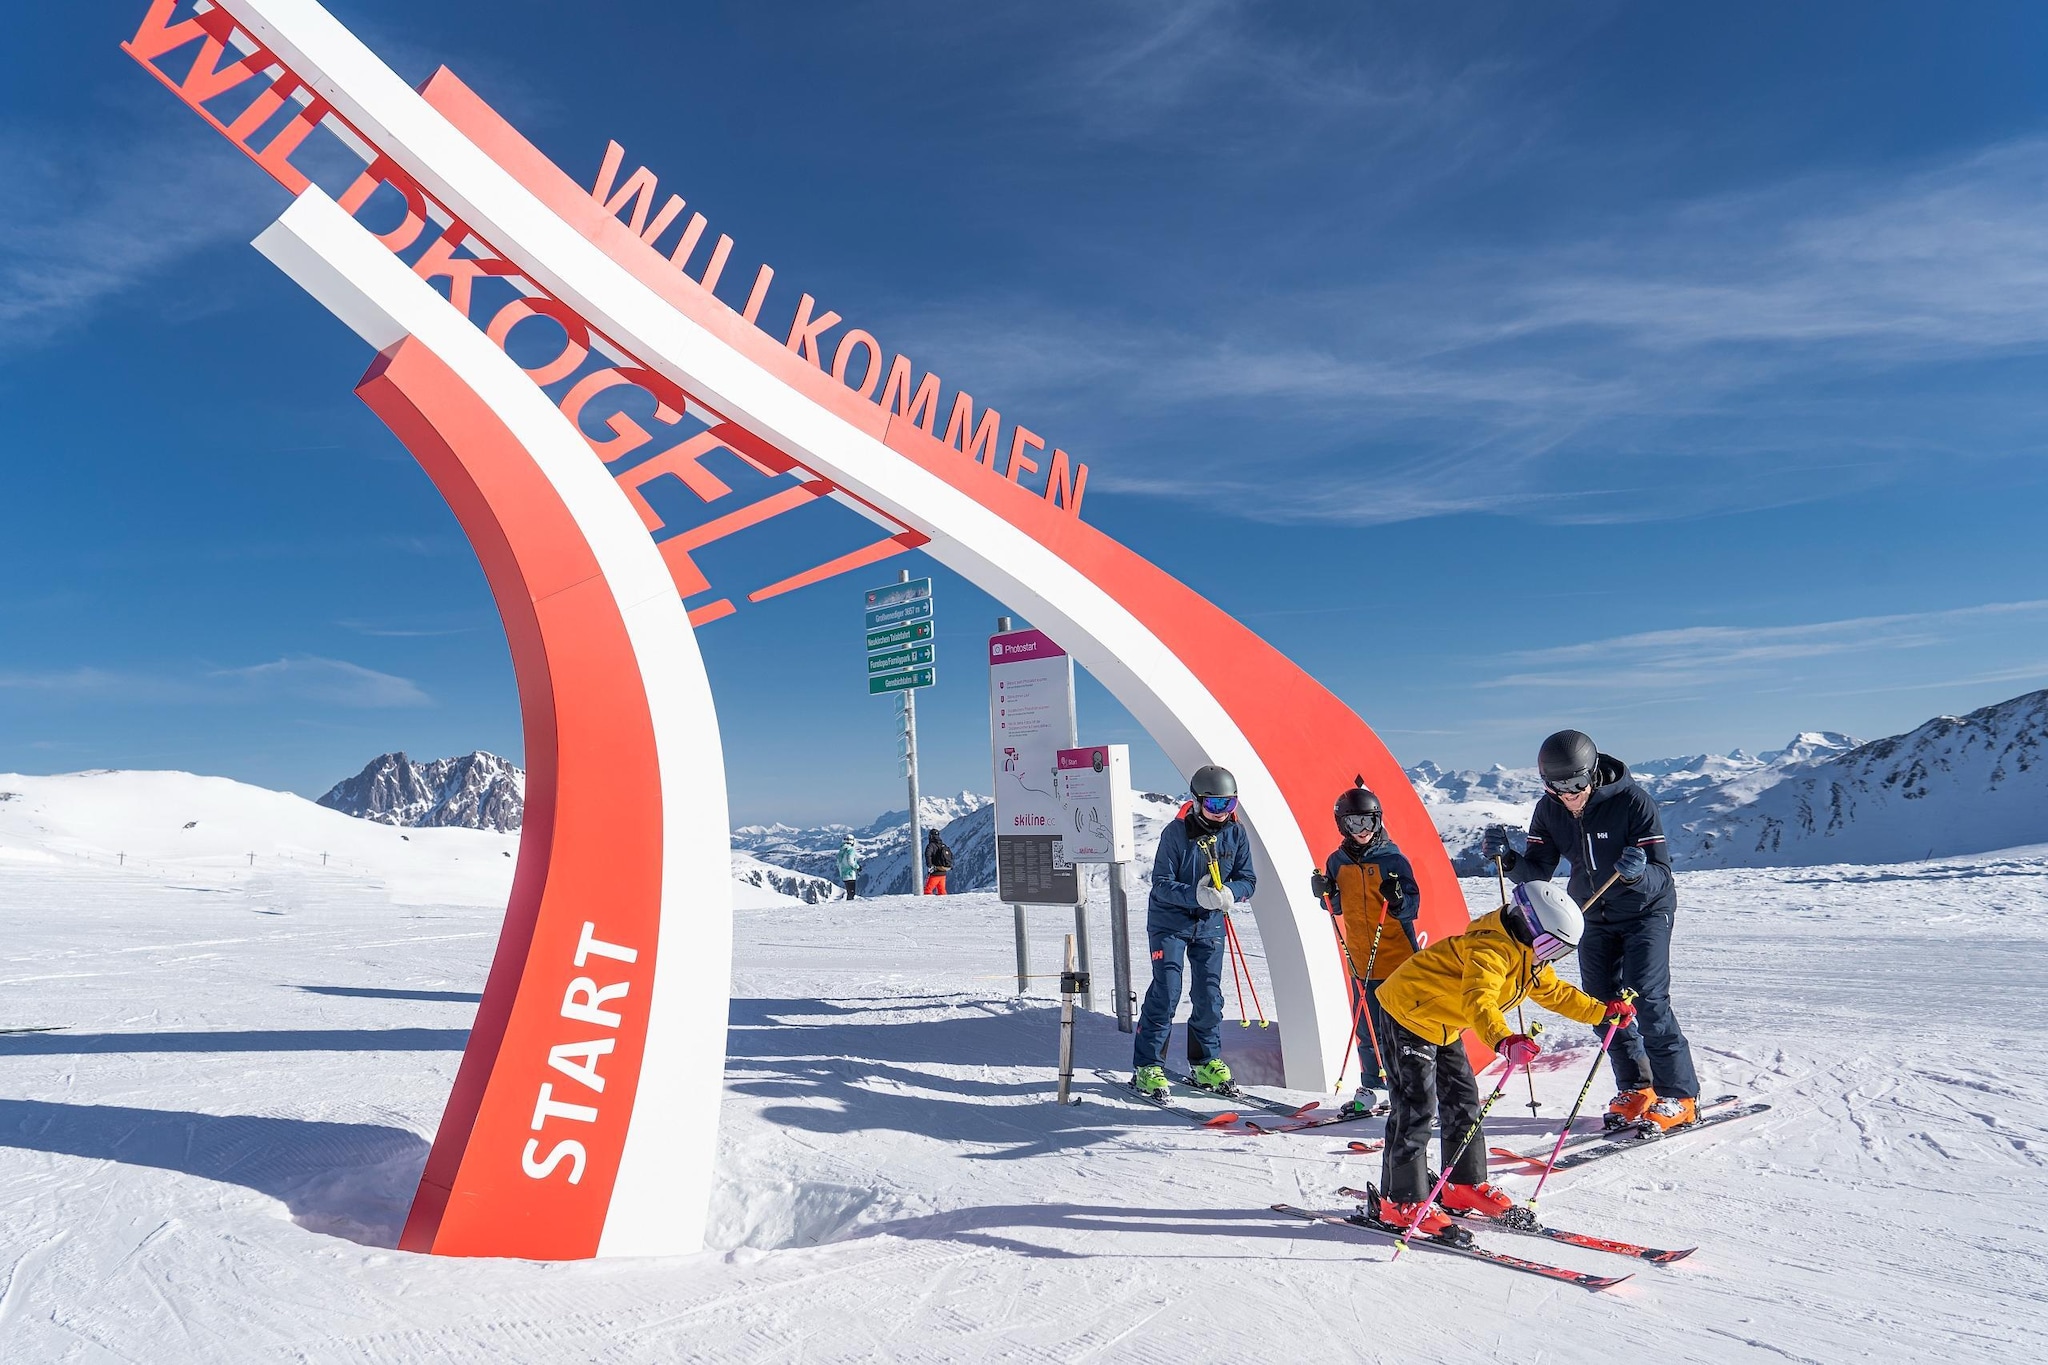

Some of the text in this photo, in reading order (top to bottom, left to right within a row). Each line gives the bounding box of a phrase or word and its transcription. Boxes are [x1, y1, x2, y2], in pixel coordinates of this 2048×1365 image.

[591, 139, 1088, 519] WILLKOMMEN
[1005, 641, 1037, 654] Photostart
[1373, 925, 1383, 948] LEKI
[521, 921, 638, 1185] START
[1482, 1090, 1500, 1117] LEKI
[1578, 1080, 1593, 1105] LEKI
